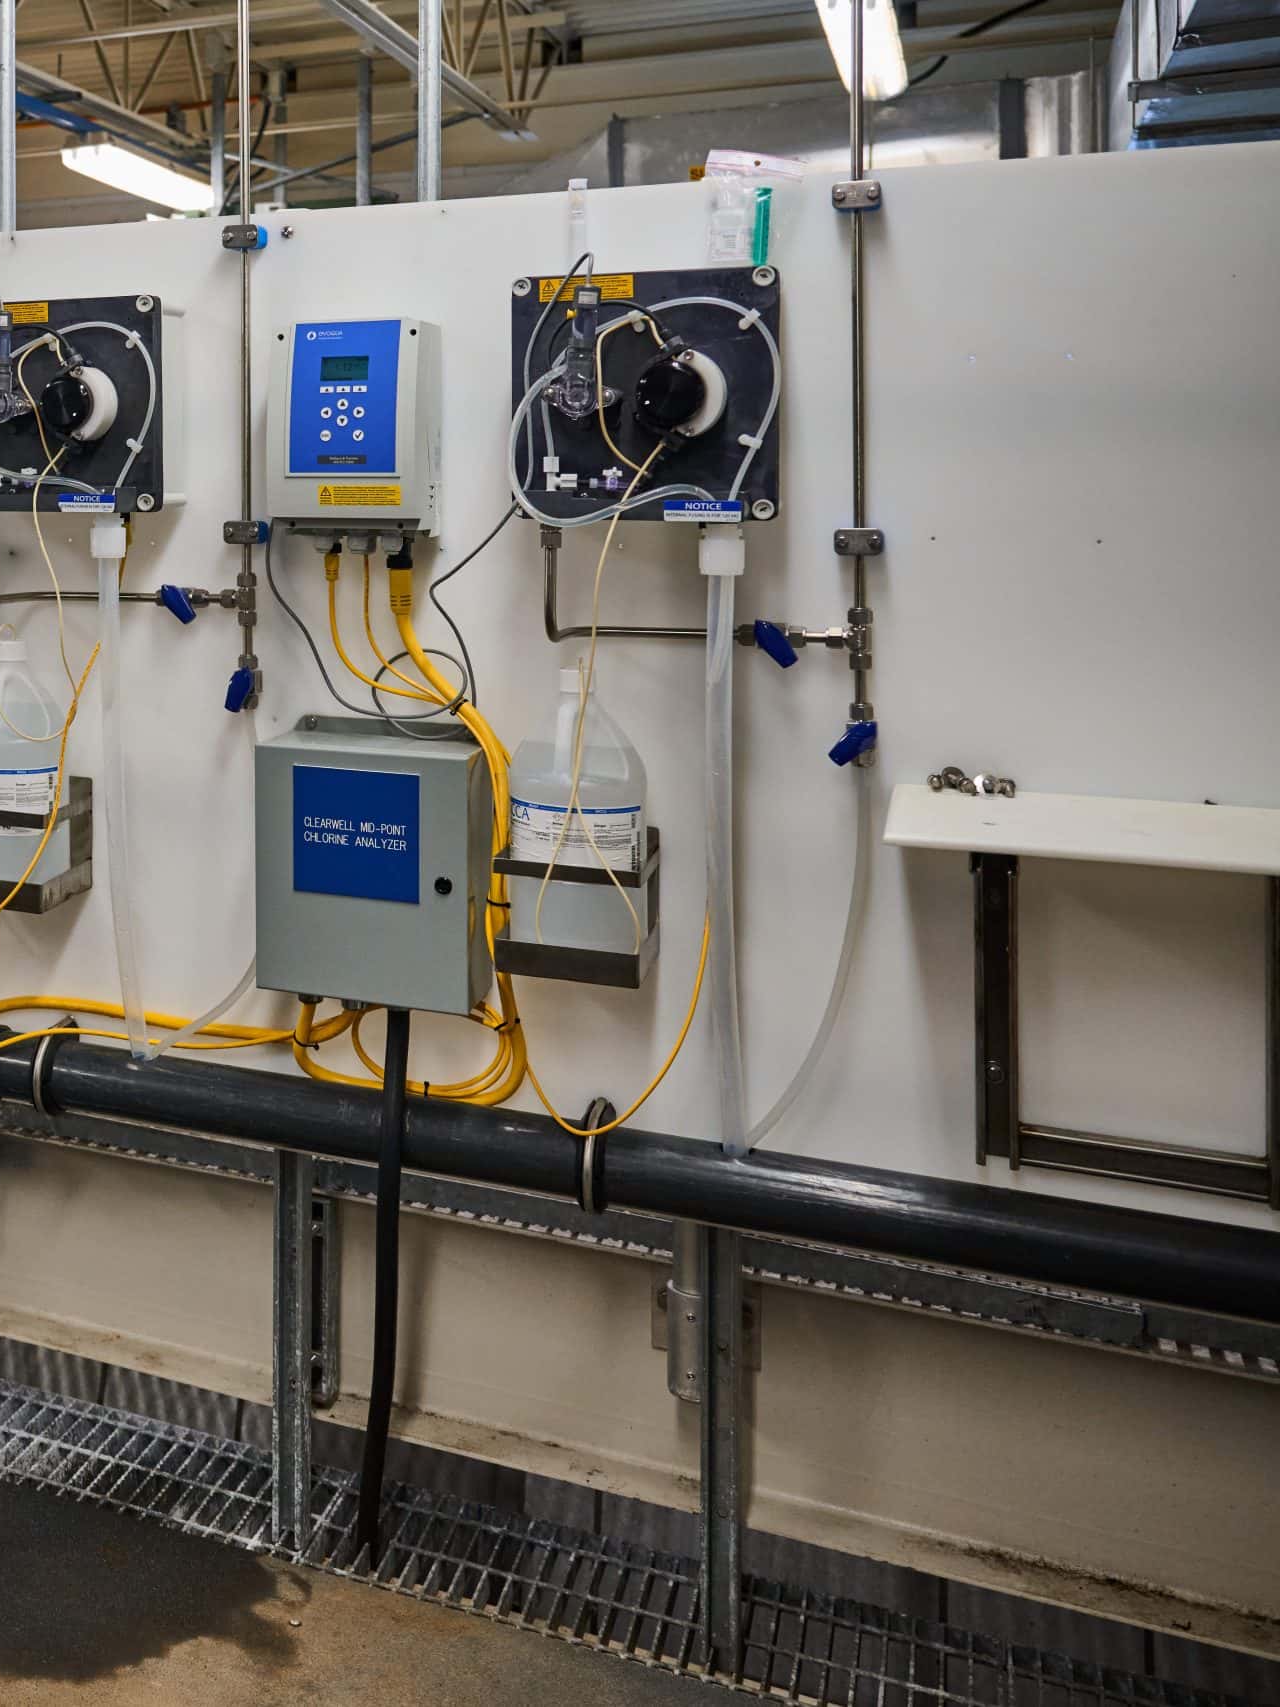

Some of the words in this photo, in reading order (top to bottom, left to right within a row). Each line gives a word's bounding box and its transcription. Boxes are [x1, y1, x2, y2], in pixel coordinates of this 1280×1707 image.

[685, 502, 722, 510] NOTICE
[303, 816, 356, 831] CLEARWELL
[360, 822, 407, 836] MID-POINT
[303, 830, 350, 846] CHLORINE
[355, 836, 407, 851] ANALYZER
